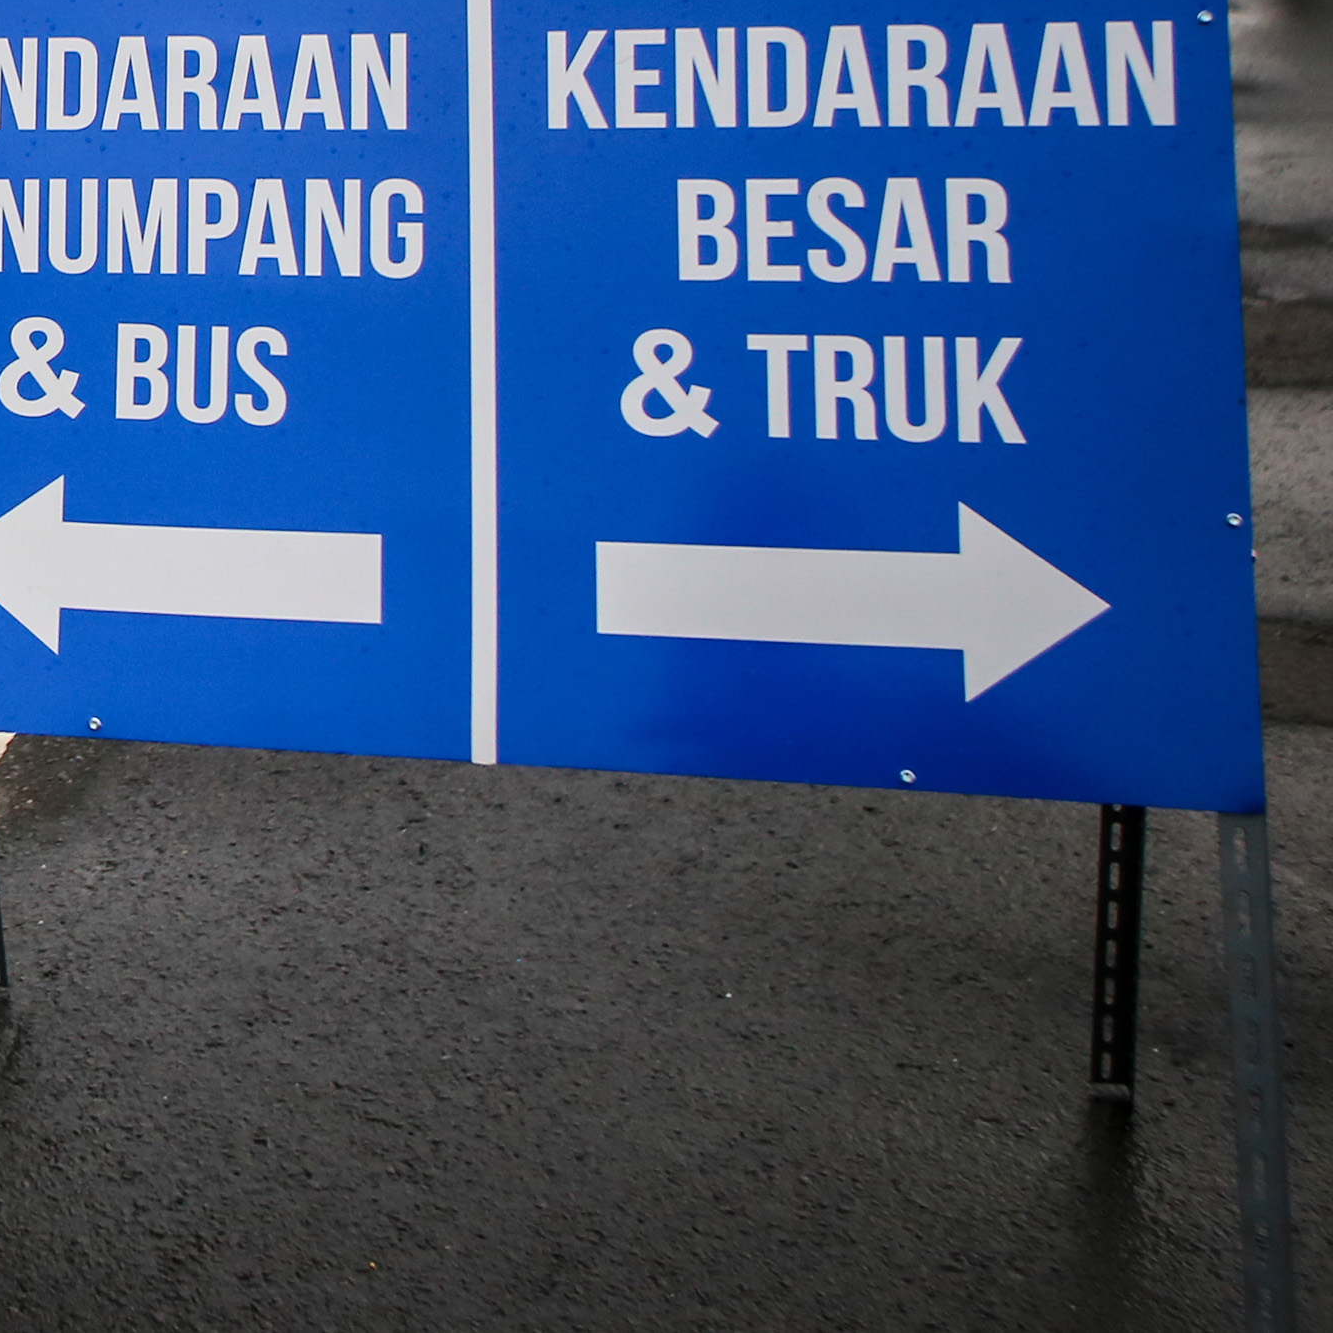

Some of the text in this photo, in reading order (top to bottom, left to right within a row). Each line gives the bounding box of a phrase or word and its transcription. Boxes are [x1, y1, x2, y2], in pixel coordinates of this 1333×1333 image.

[547, 20, 1176, 130] KENDARAAN
[677, 177, 1012, 284] BESAR
[115, 322, 288, 426] BUS
[620, 328, 1027, 444] & TRUK
